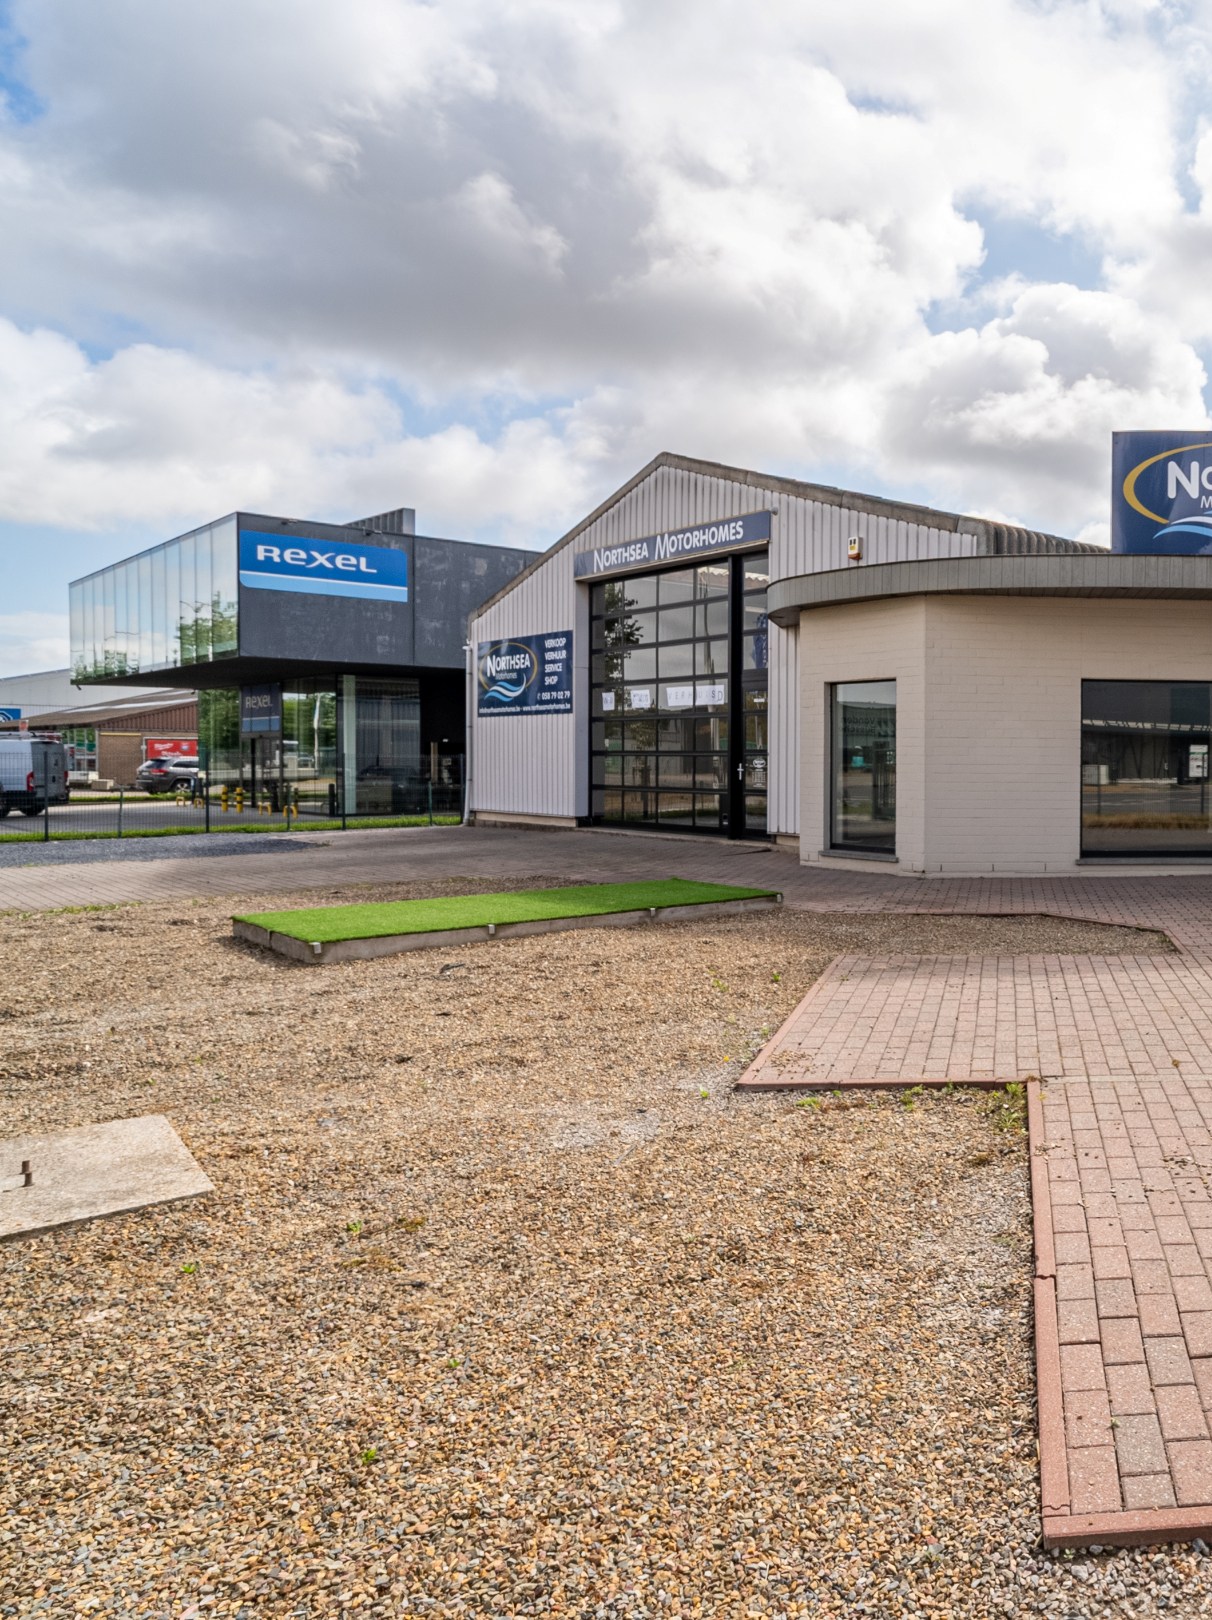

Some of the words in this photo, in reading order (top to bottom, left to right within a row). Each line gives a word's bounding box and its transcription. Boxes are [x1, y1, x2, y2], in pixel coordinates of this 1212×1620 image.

[593, 542, 648, 573] NORTHSEA
[654, 520, 744, 560] MOTORHOMES
[545, 638, 566, 648] VERKOOP
[545, 650, 566, 660] VERHUUR
[487, 654, 530, 677] NORTHSEA
[545, 663, 562, 672] SERVICE
[545, 676, 558, 685] SHOP
